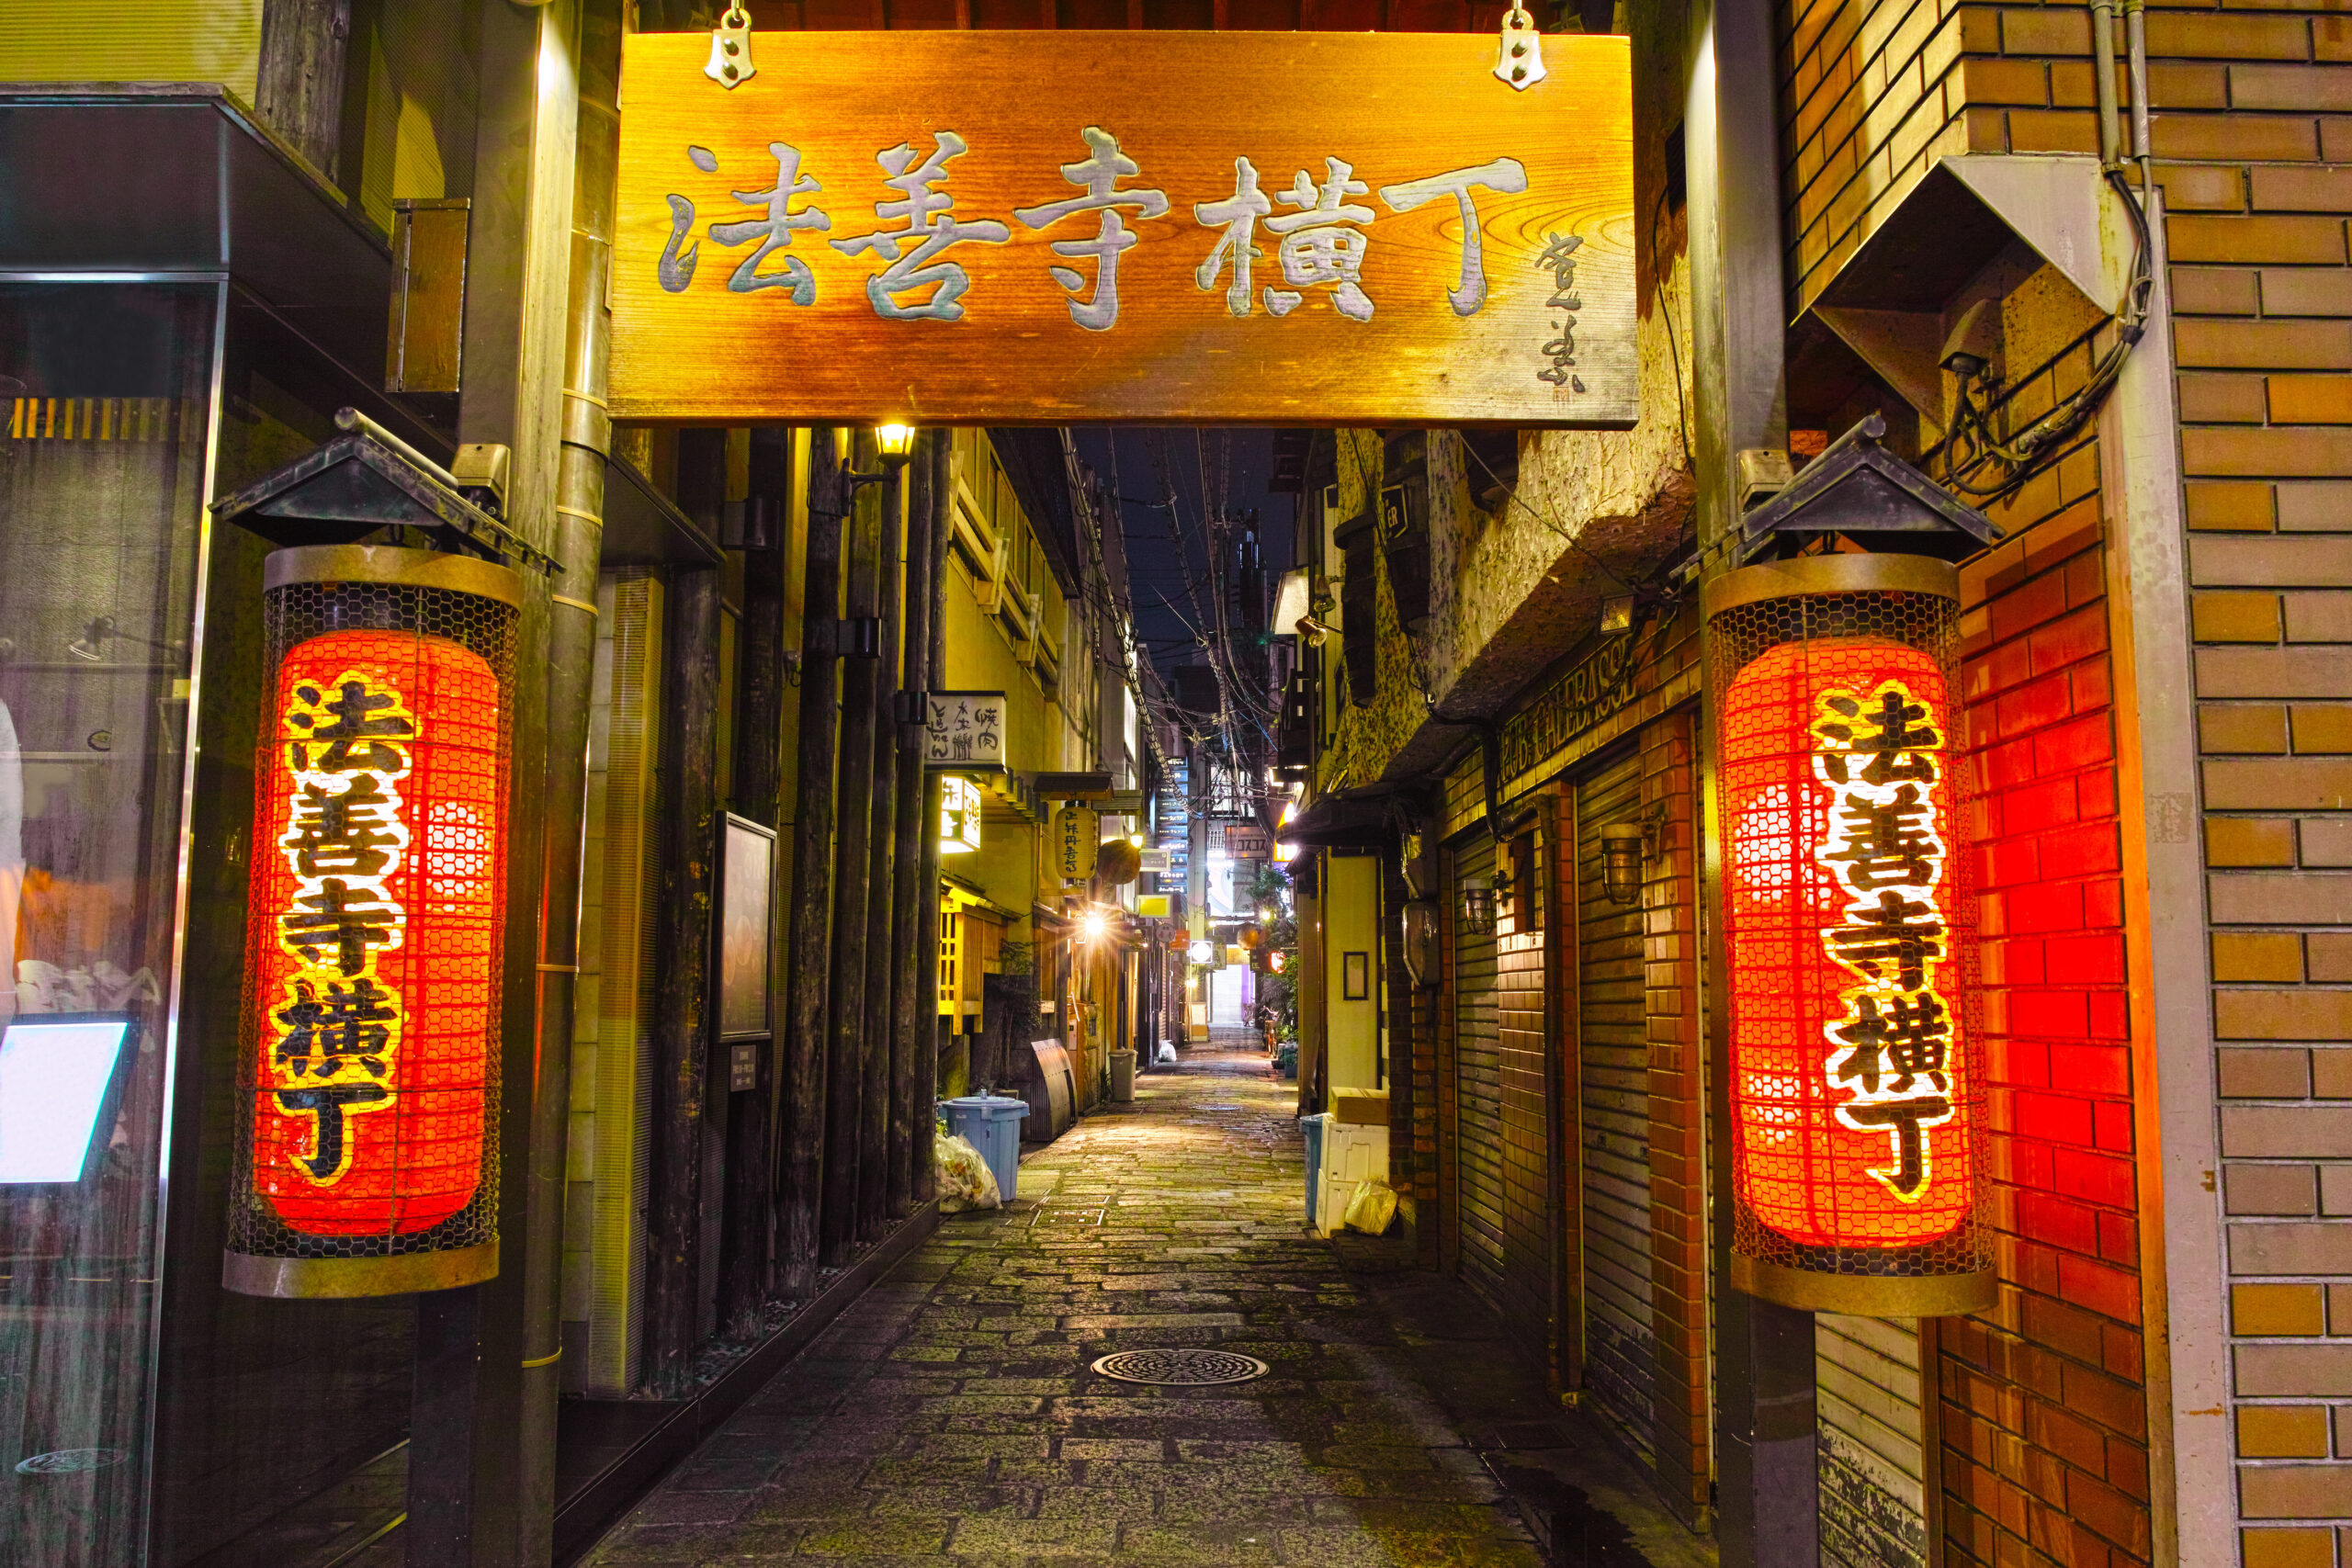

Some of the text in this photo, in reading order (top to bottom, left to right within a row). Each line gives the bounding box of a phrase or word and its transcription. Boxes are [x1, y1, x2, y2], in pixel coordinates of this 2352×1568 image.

[658, 126, 1528, 332] 法善寺横丁
[974, 706, 1000, 750] 焼肉
[272, 674, 418, 1183] 法善寺横丁
[1238, 839, 1266, 852] コスコス
[1815, 683, 1952, 1199] 法善寺横丁
